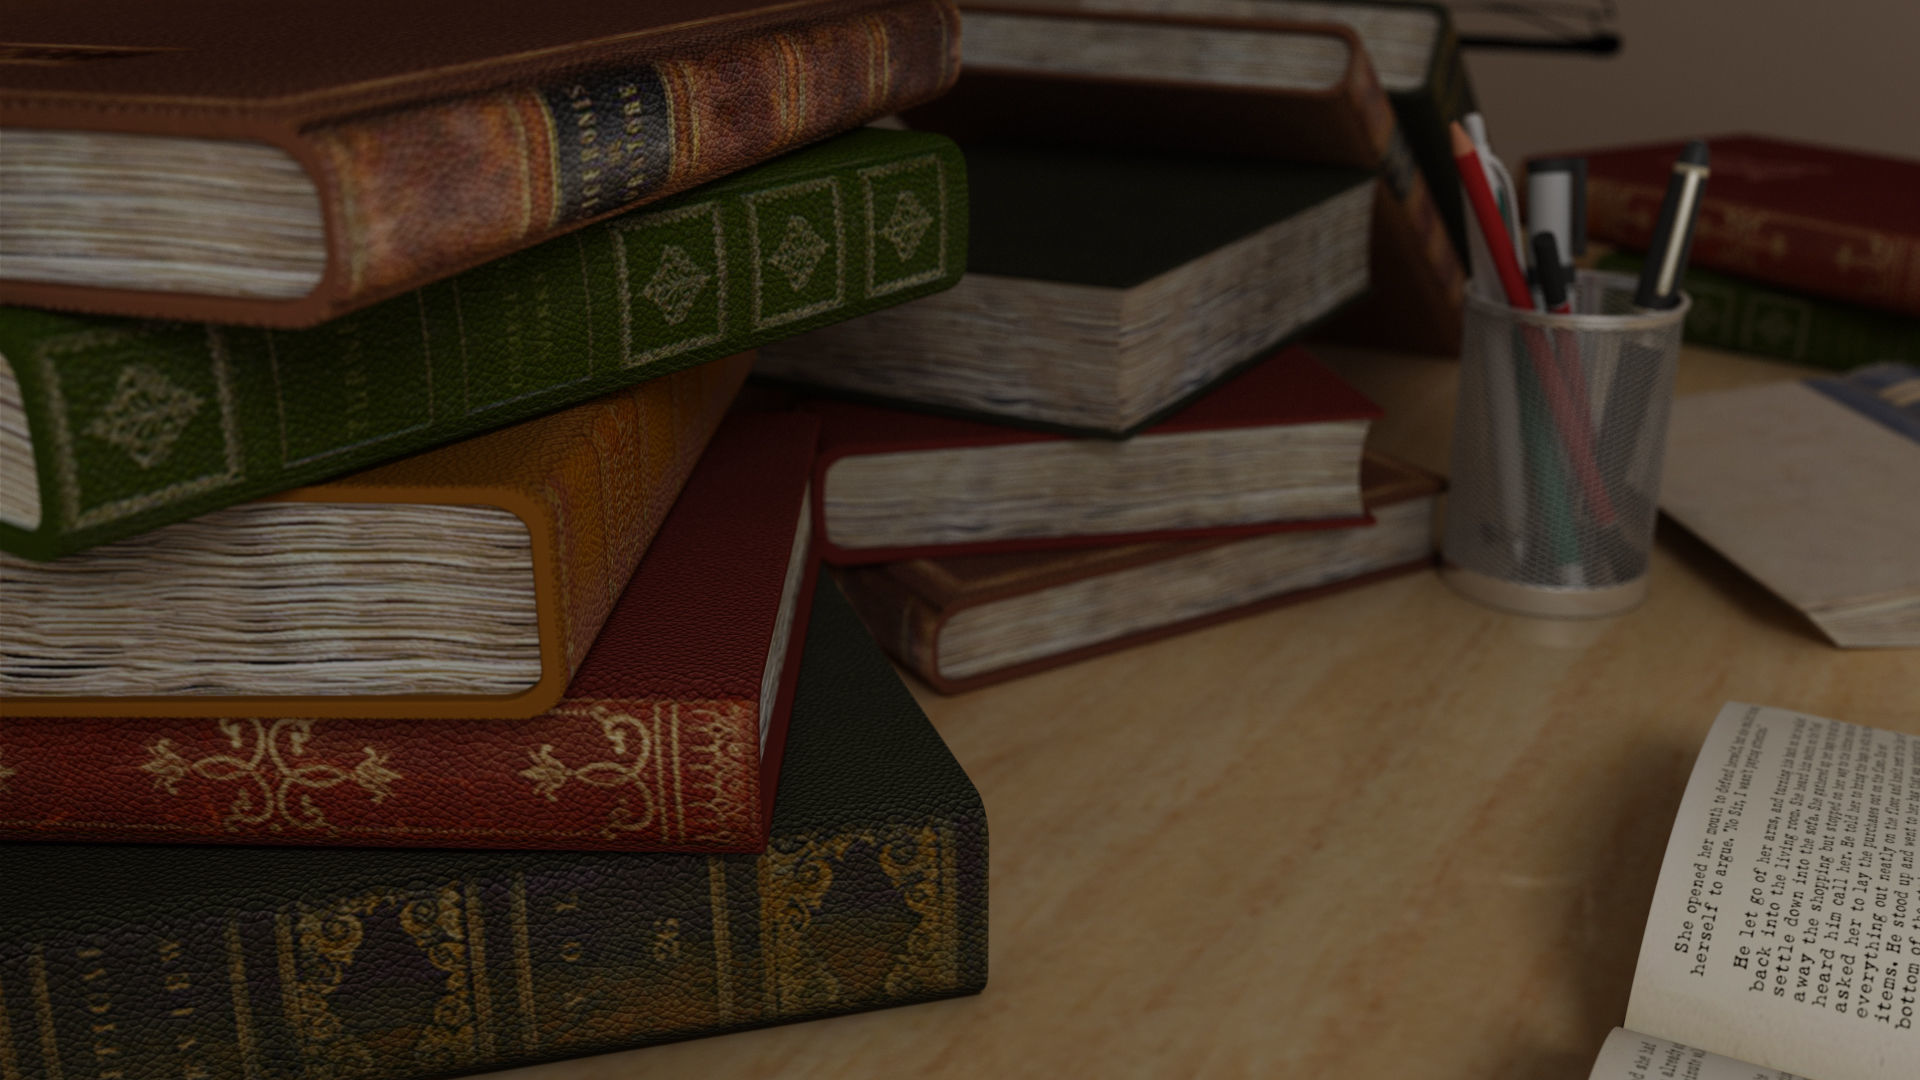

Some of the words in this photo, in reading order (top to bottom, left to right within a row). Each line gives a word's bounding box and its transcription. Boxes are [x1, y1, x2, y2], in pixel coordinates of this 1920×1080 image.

[1714, 794, 1726, 804] to
[1770, 796, 1783, 814] and
[1808, 797, 1822, 812] She
[1706, 807, 1723, 836] mouth
[1764, 816, 1781, 842] arms,
[1805, 813, 1819, 836] sofa.
[1826, 800, 1842, 833] stopped
[1844, 814, 1858, 833] told
[1864, 806, 1879, 850] purchases
[1885, 817, 1897, 831] the
[1906, 816, 1918, 825] to
[1697, 837, 1714, 859] her
[1800, 838, 1814, 855] the
[1819, 834, 1835, 852] but
[1840, 835, 1854, 848] He
[1885, 833, 1895, 844] on
[1905, 827, 1917, 847] went
[1756, 844, 1772, 865] her
[1774, 833, 1798, 870] living
[1836, 851, 1852, 874] her.
[1859, 850, 1872, 868] the
[1879, 845, 1896, 882] neatly
[1899, 849, 1914, 870] and
[1753, 866, 1767, 884] of
[1771, 874, 1786, 896] the
[1792, 858, 1810, 886] into
[1810, 854, 1834, 912] shopping
[1852, 871, 1872, 894] lay
[1899, 872, 1914, 887] up
[1687, 862, 1707, 914] opened
[1750, 887, 1764, 906] go
[1832, 878, 1848, 907] call
[1875, 886, 1888, 908] out
[1690, 901, 1718, 978] herself
[1709, 881, 1723, 896] to
[1716, 837, 1734, 877] argue.
[1784, 891, 1804, 927] down
[1851, 897, 1865, 912] to
[1893, 890, 1908, 928] stood
[1739, 911, 1758, 939] let
[1761, 902, 1780, 938] into
[1803, 917, 1819, 945] the
[1824, 911, 1841, 942] him
[1844, 918, 1861, 947] her
[1674, 920, 1693, 954] She
[1886, 934, 1902, 955] He
[1733, 945, 1750, 971] He
[1749, 946, 1771, 992] back
[1774, 934, 1795, 998] settle
[1857, 912, 1886, 1019] everything
[1794, 952, 1815, 1003] away
[1812, 947, 1835, 1008] heard
[1835, 953, 1855, 1014] asked
[1895, 962, 1920, 1030] bottom
[1909, 936, 1920, 956] of
[1874, 961, 1898, 1024] items.
